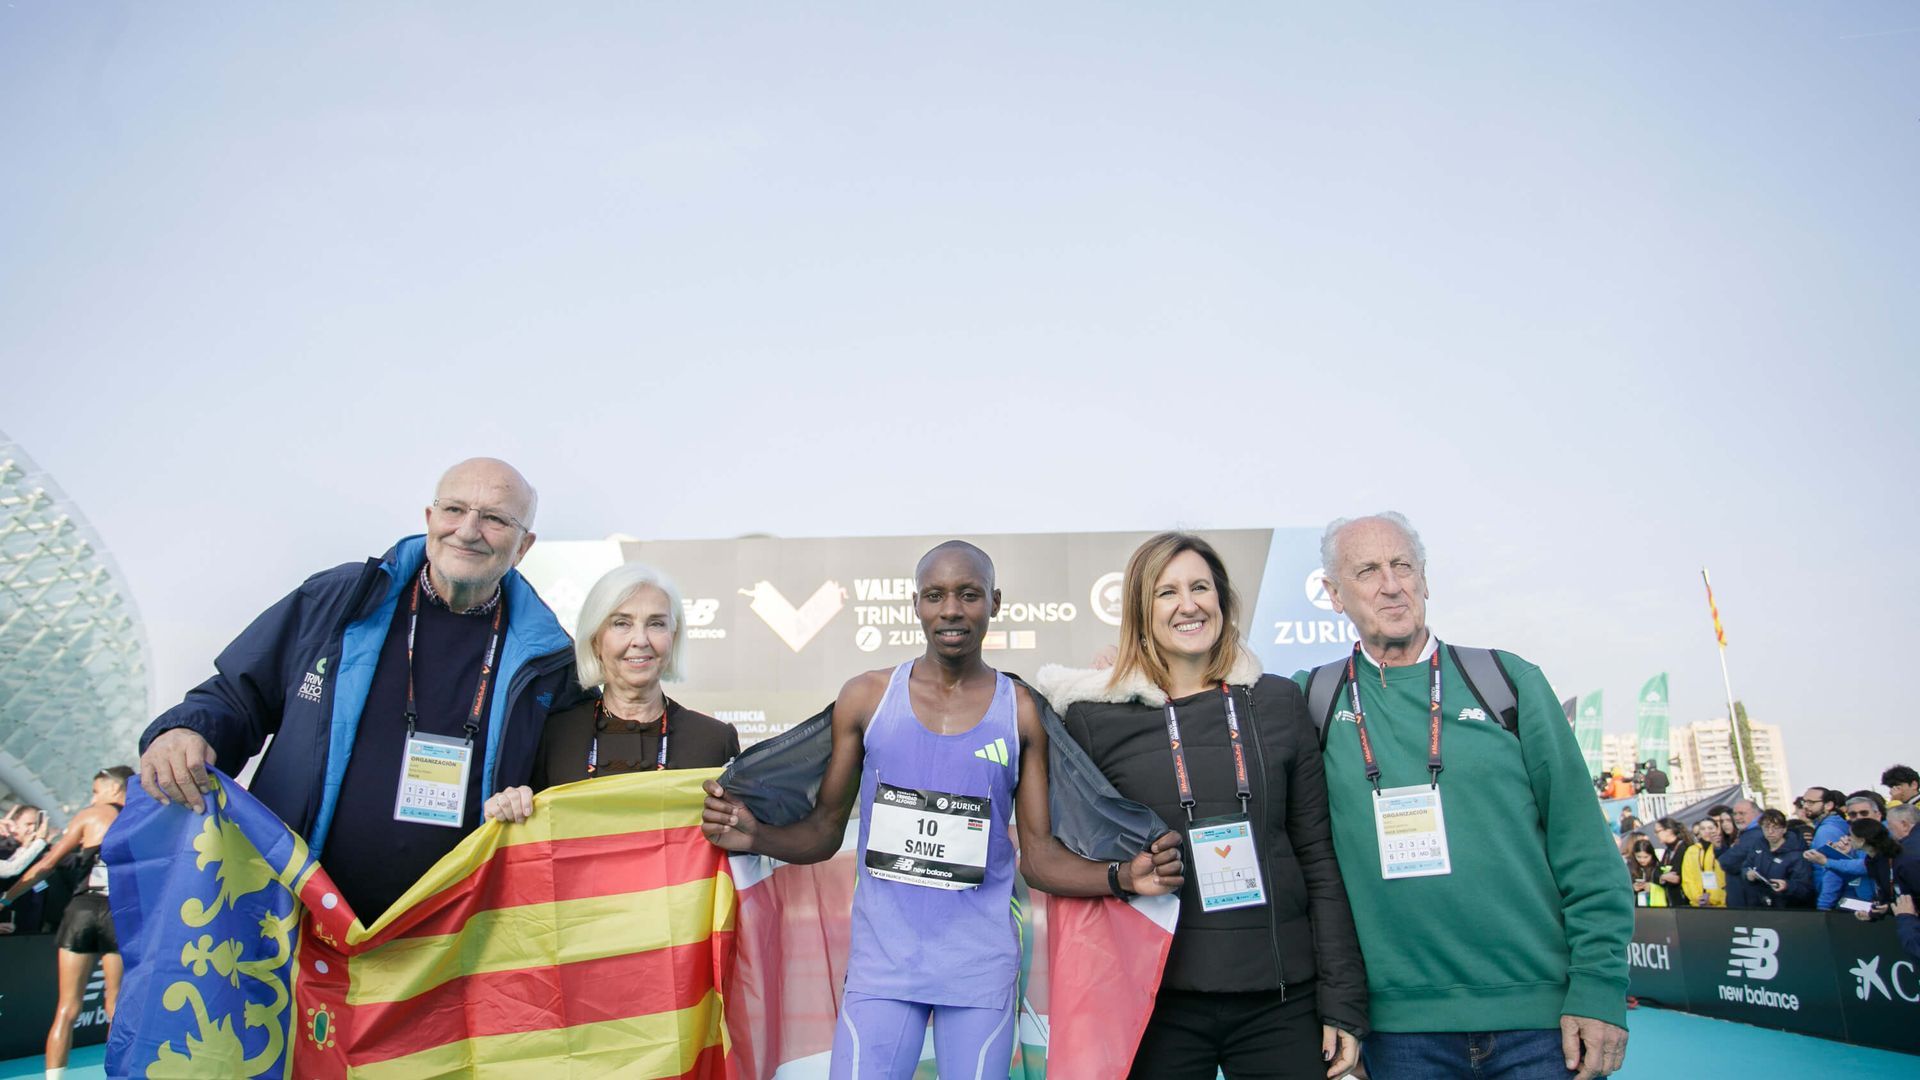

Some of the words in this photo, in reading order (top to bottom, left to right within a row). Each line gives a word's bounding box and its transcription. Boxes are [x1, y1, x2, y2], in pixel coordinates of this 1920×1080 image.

[854, 578, 918, 600] VALEN
[854, 605, 921, 625] TRINI
[989, 602, 1077, 622] FONSO
[687, 628, 726, 639] alance
[888, 630, 927, 645] ZUR
[1274, 621, 1360, 644] ZURIC
[304, 672, 324, 686] TRIN
[300, 682, 322, 697] ALFO
[410, 756, 457, 767] ORGANIZACIÓN
[951, 801, 981, 812] ZURICH
[917, 818, 938, 837] 10
[904, 839, 946, 858] SAWE
[926, 867, 953, 878] balance
[1627, 942, 1670, 970] RICH
[1718, 984, 1743, 1002] new
[1744, 984, 1799, 1011] balance
